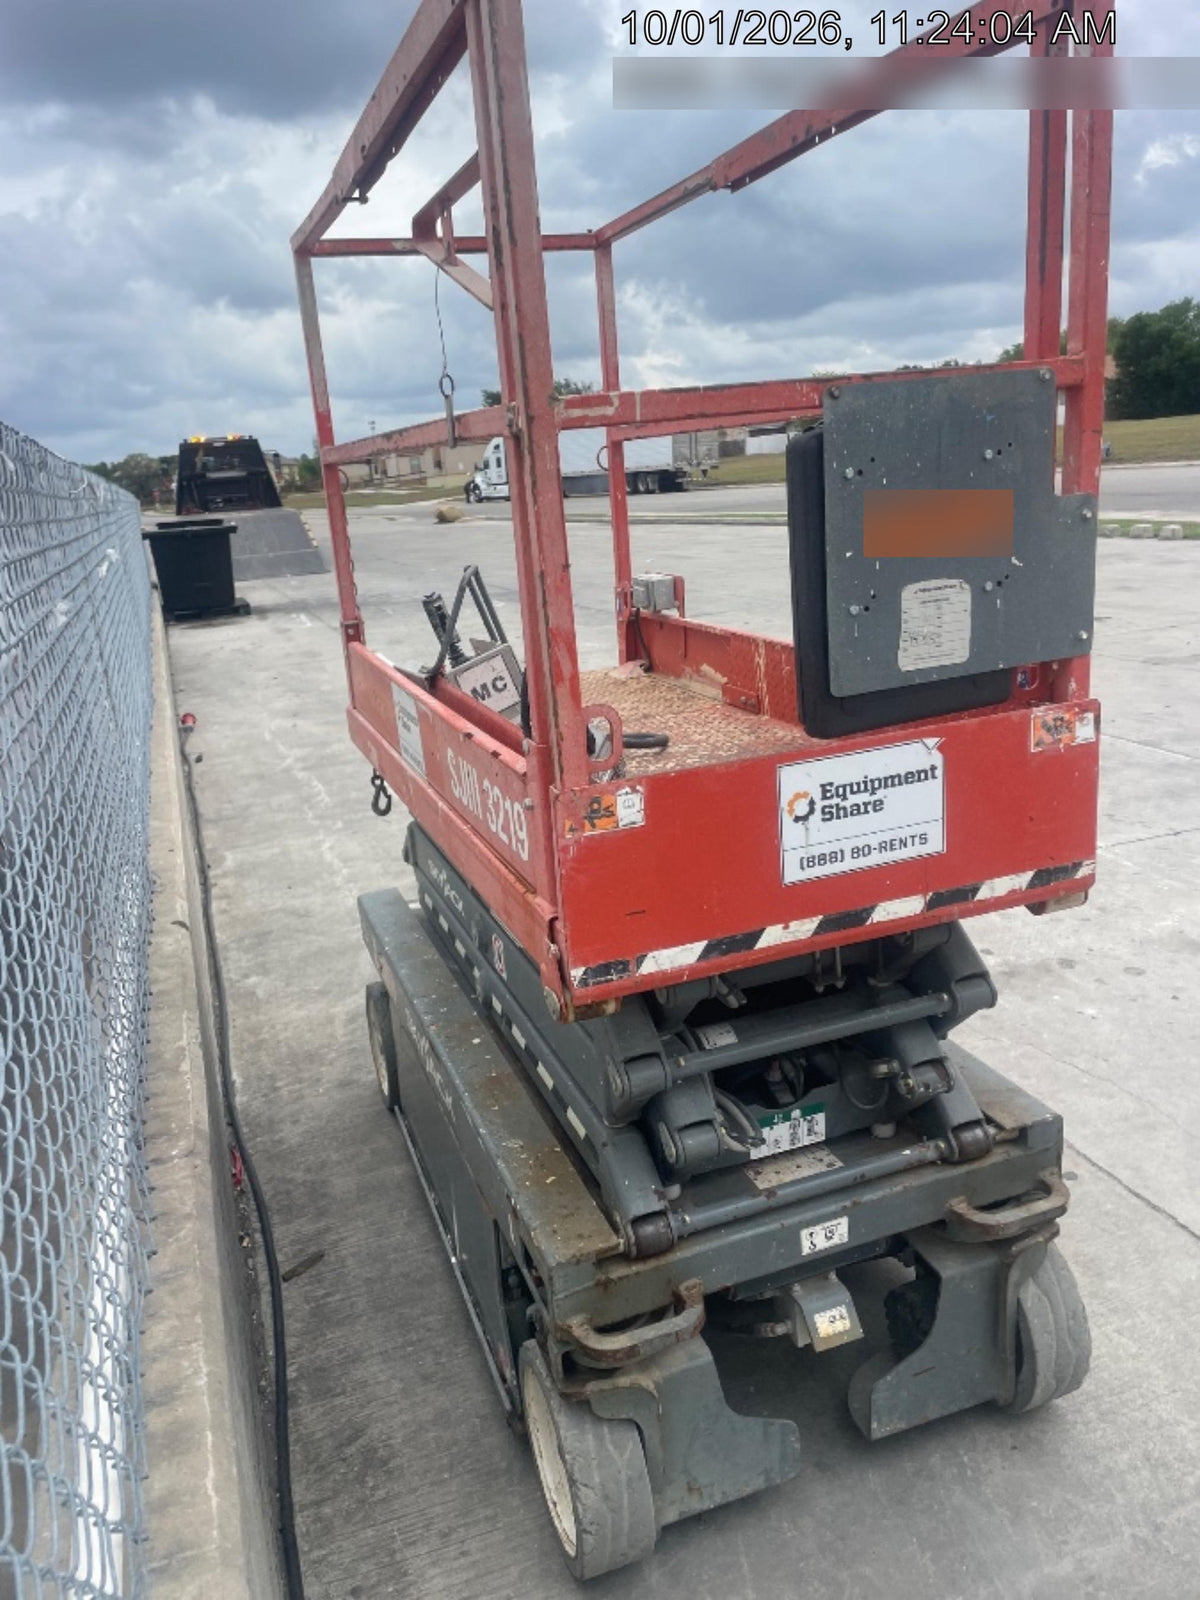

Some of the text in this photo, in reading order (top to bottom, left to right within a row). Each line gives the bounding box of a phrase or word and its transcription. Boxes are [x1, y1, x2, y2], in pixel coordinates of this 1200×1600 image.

[819, 764, 938, 801] Equipment
[482, 777, 529, 861] 3219
[821, 797, 884, 822] Share
[799, 848, 845, 871] (888)
